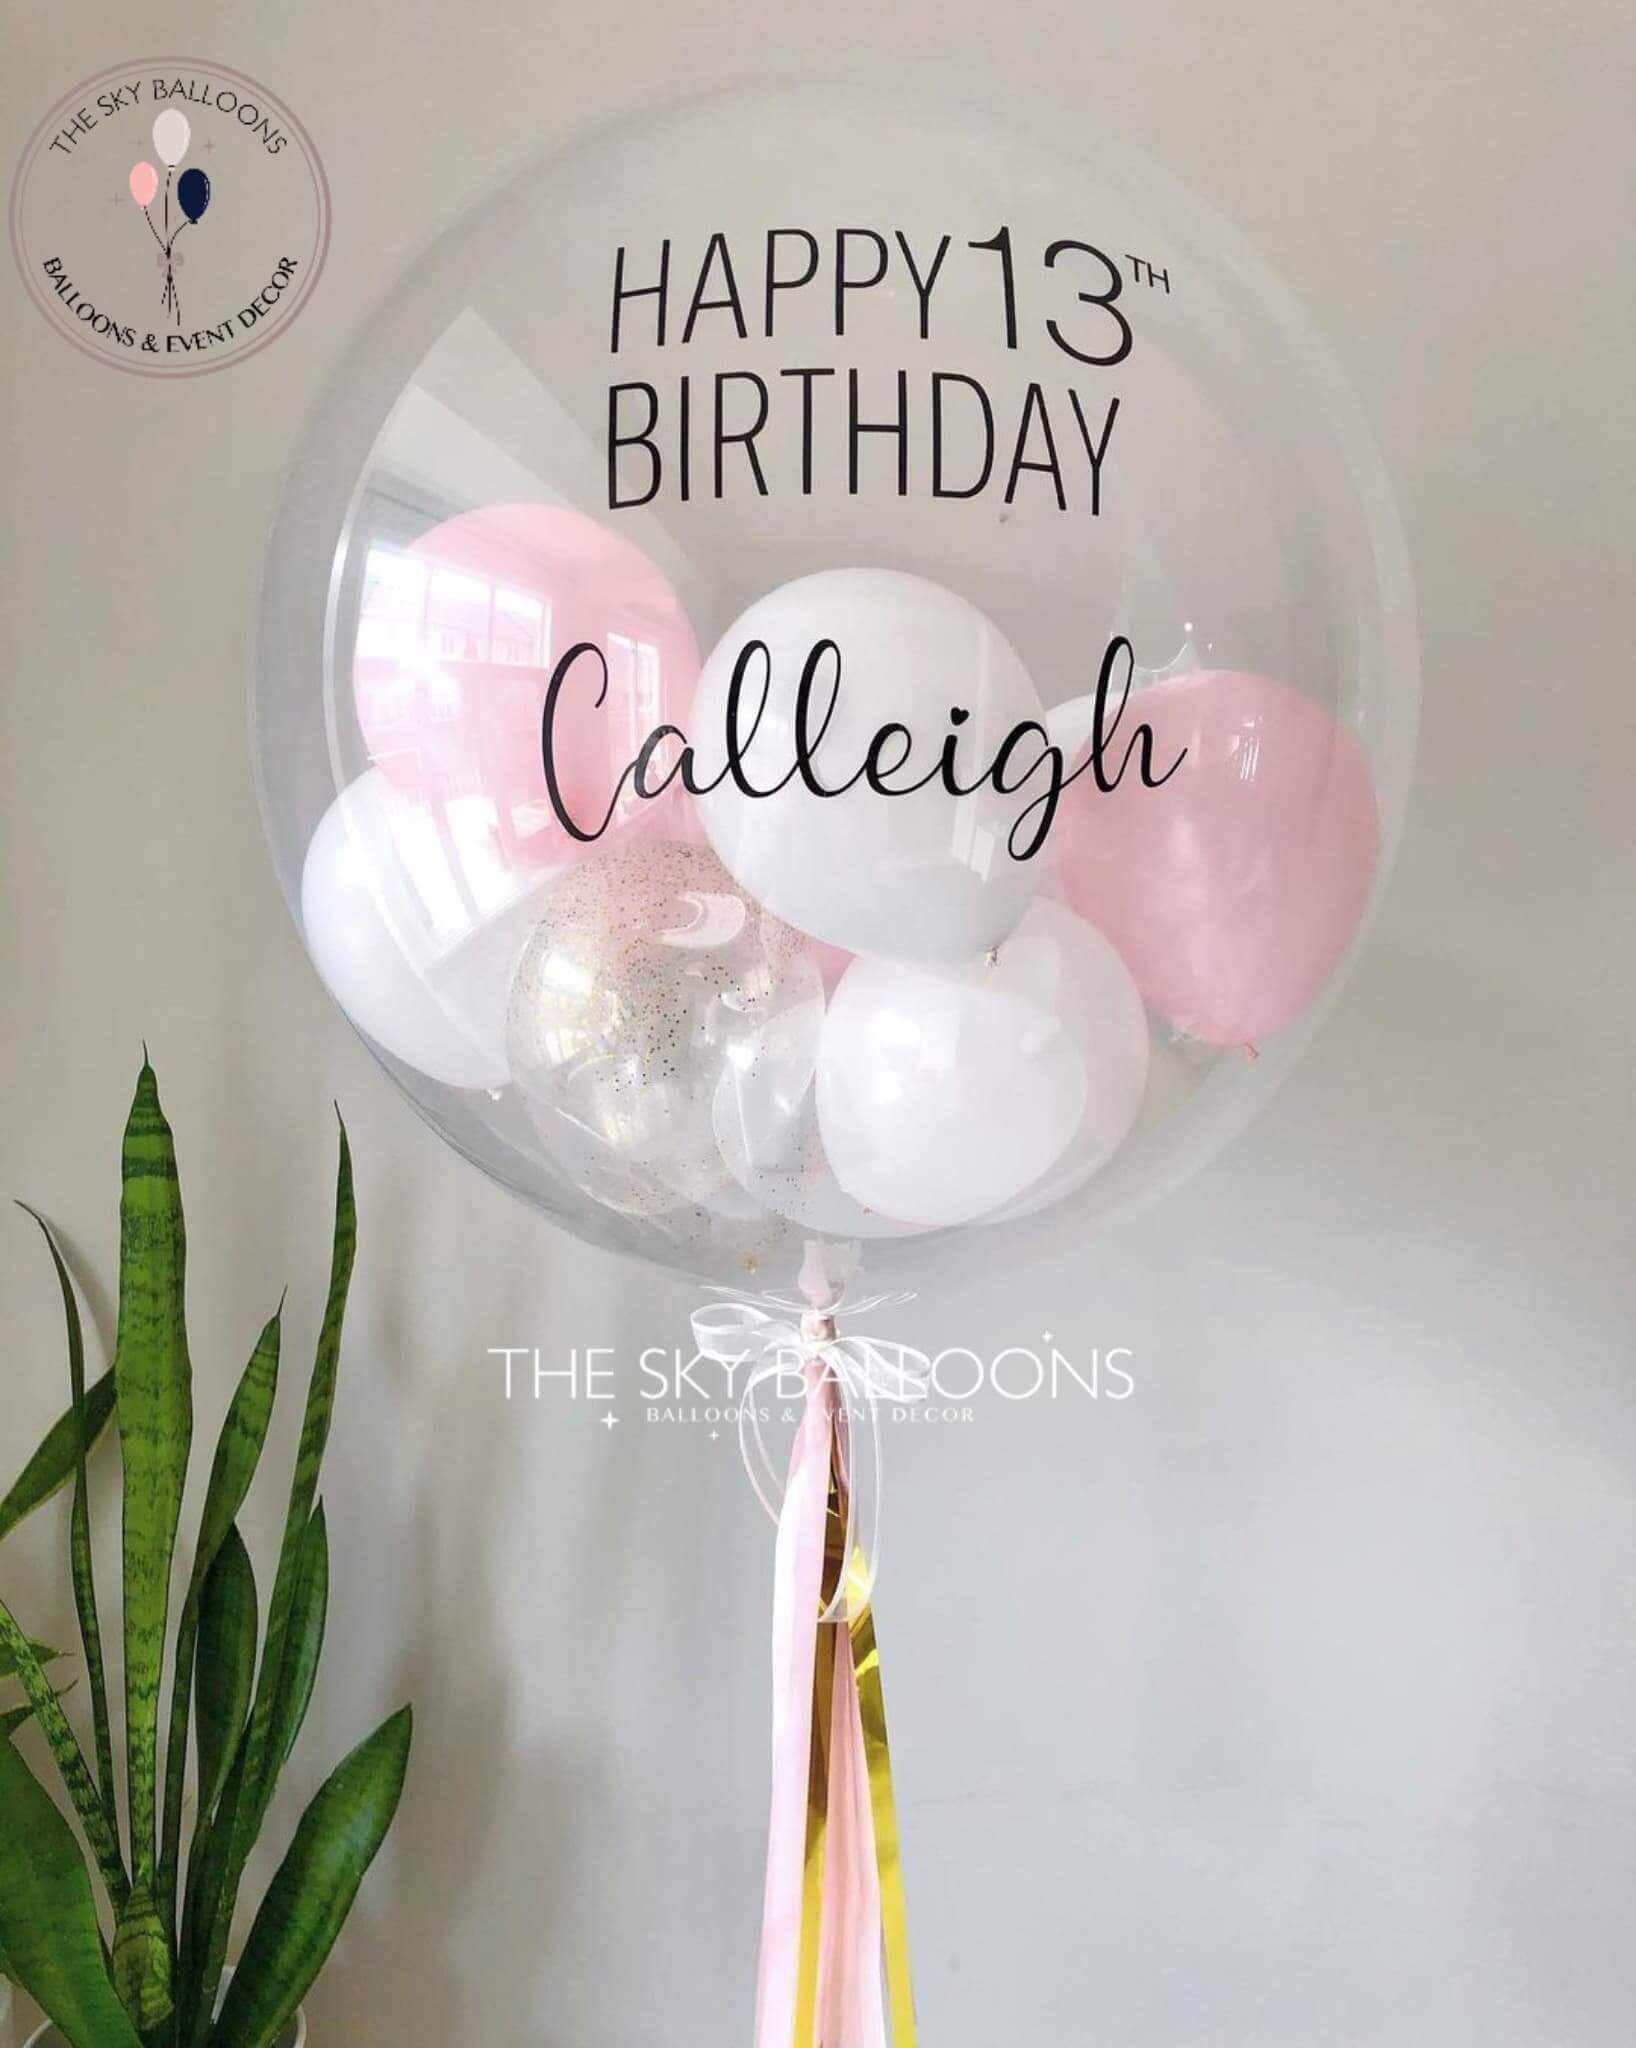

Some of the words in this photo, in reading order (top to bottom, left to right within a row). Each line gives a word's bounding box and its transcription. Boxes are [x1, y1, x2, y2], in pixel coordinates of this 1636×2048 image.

[611, 228, 952, 353] HAPPY
[608, 368, 1121, 516] BIRTHDAY
[541, 635, 1188, 861] Calleigh
